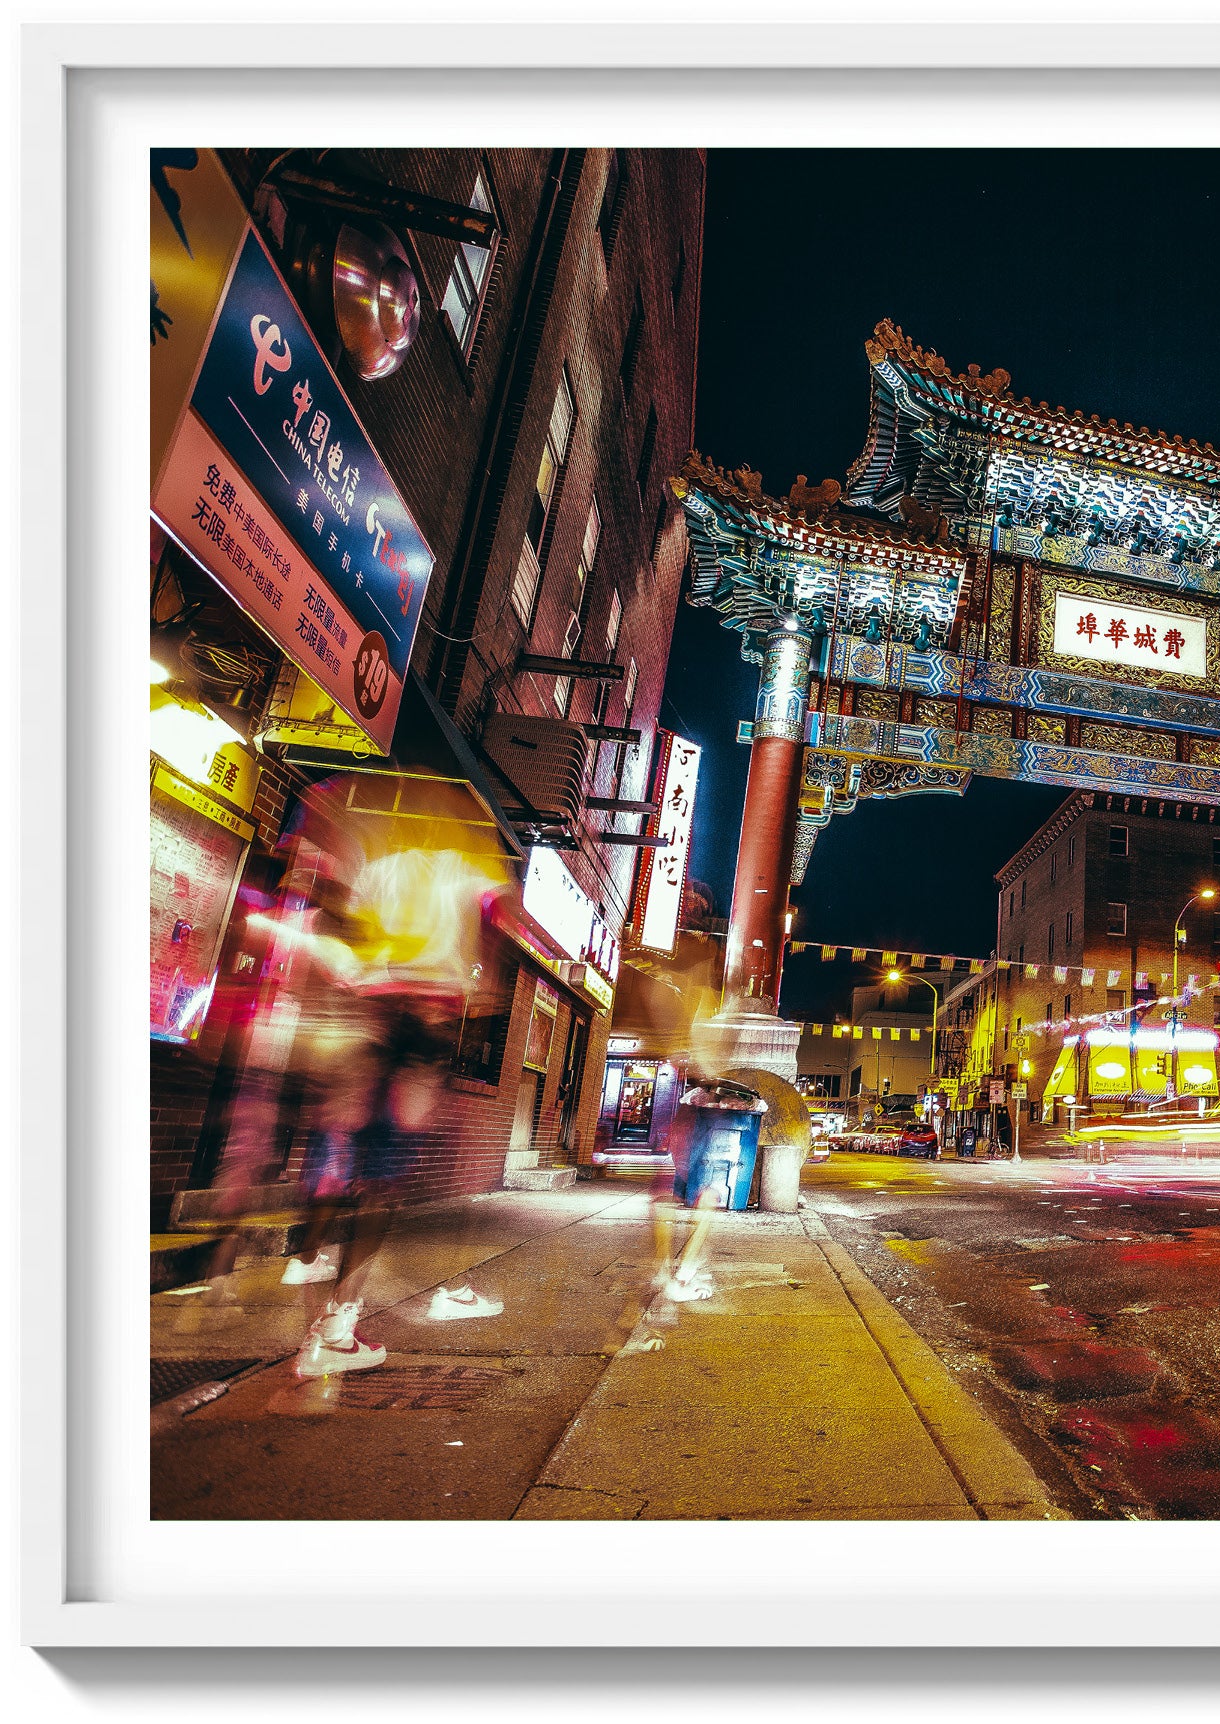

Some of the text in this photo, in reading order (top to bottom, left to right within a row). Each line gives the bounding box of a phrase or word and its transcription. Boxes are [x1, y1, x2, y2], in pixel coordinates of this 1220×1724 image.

[282, 419, 351, 527] CHINA TELECOM
[292, 379, 360, 507] 中国电信
[191, 495, 284, 612] 无限美国本地通话
[203, 463, 292, 583] 免费中美国际长途
[358, 648, 387, 703] $19
